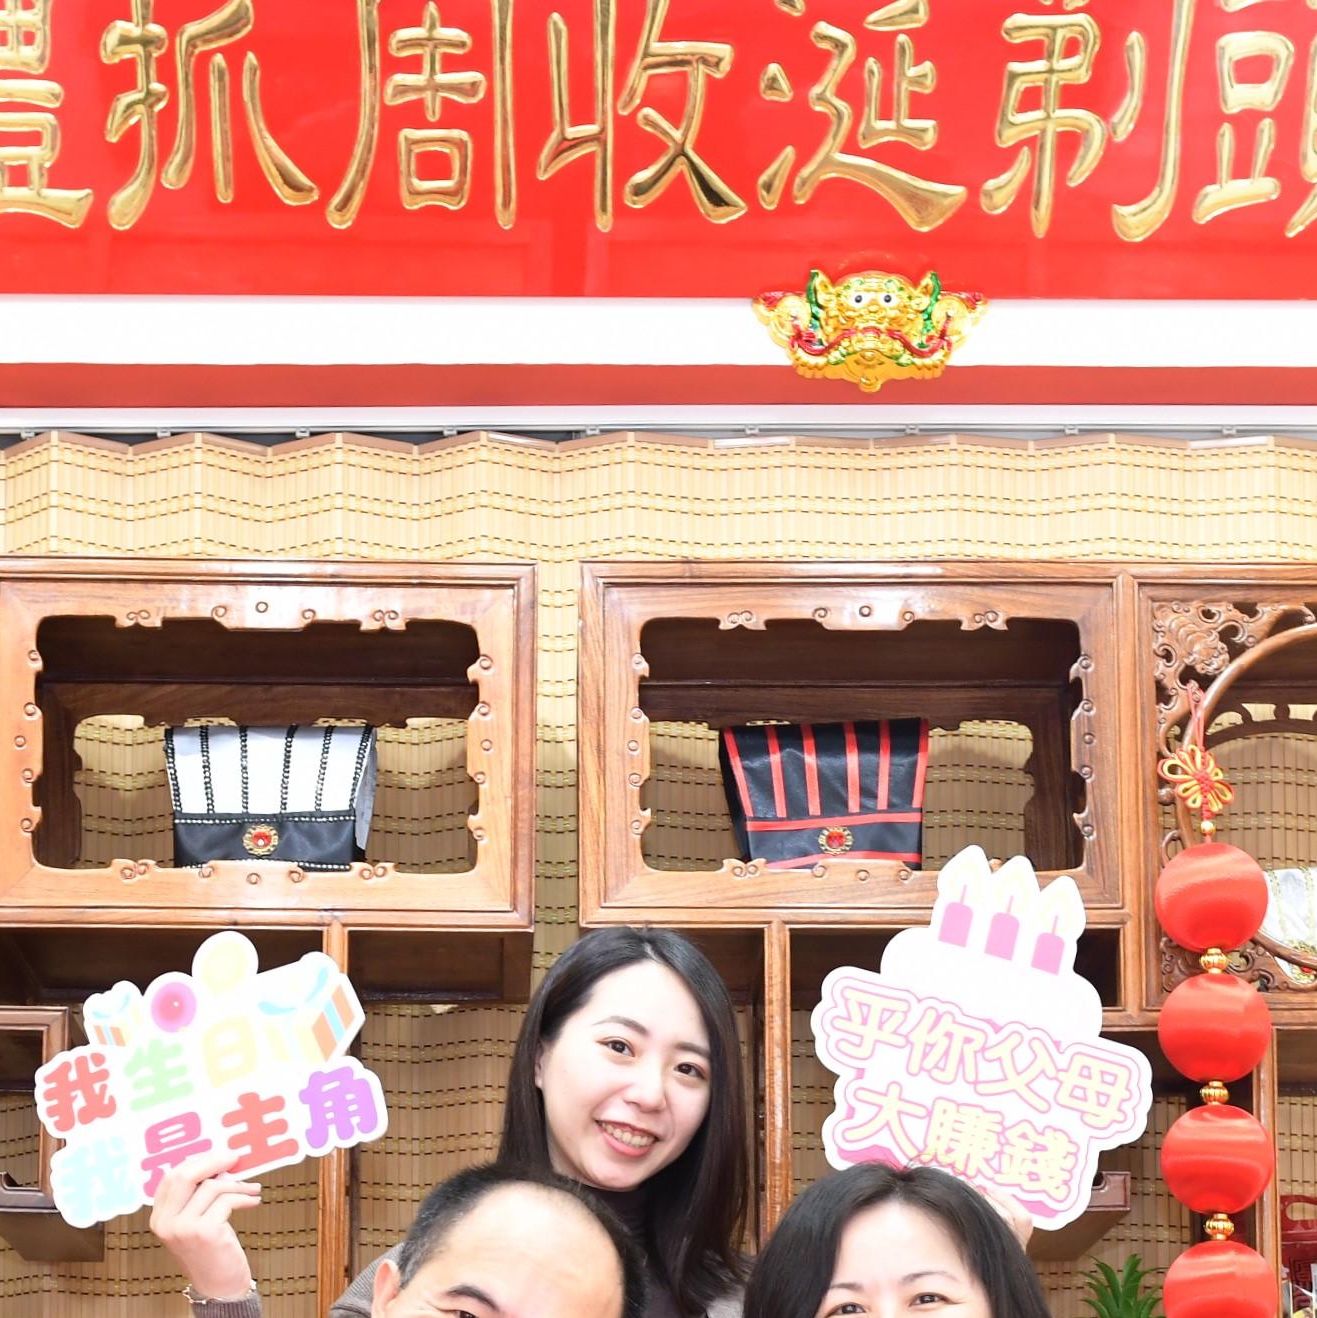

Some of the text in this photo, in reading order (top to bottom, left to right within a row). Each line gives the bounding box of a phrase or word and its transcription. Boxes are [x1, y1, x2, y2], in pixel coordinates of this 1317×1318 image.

[43, 1014, 264, 1133] 我生日
[833, 987, 1131, 1130] 乎你父母
[60, 1066, 379, 1222] 我是主角
[842, 1080, 1080, 1203] 大賺錢
